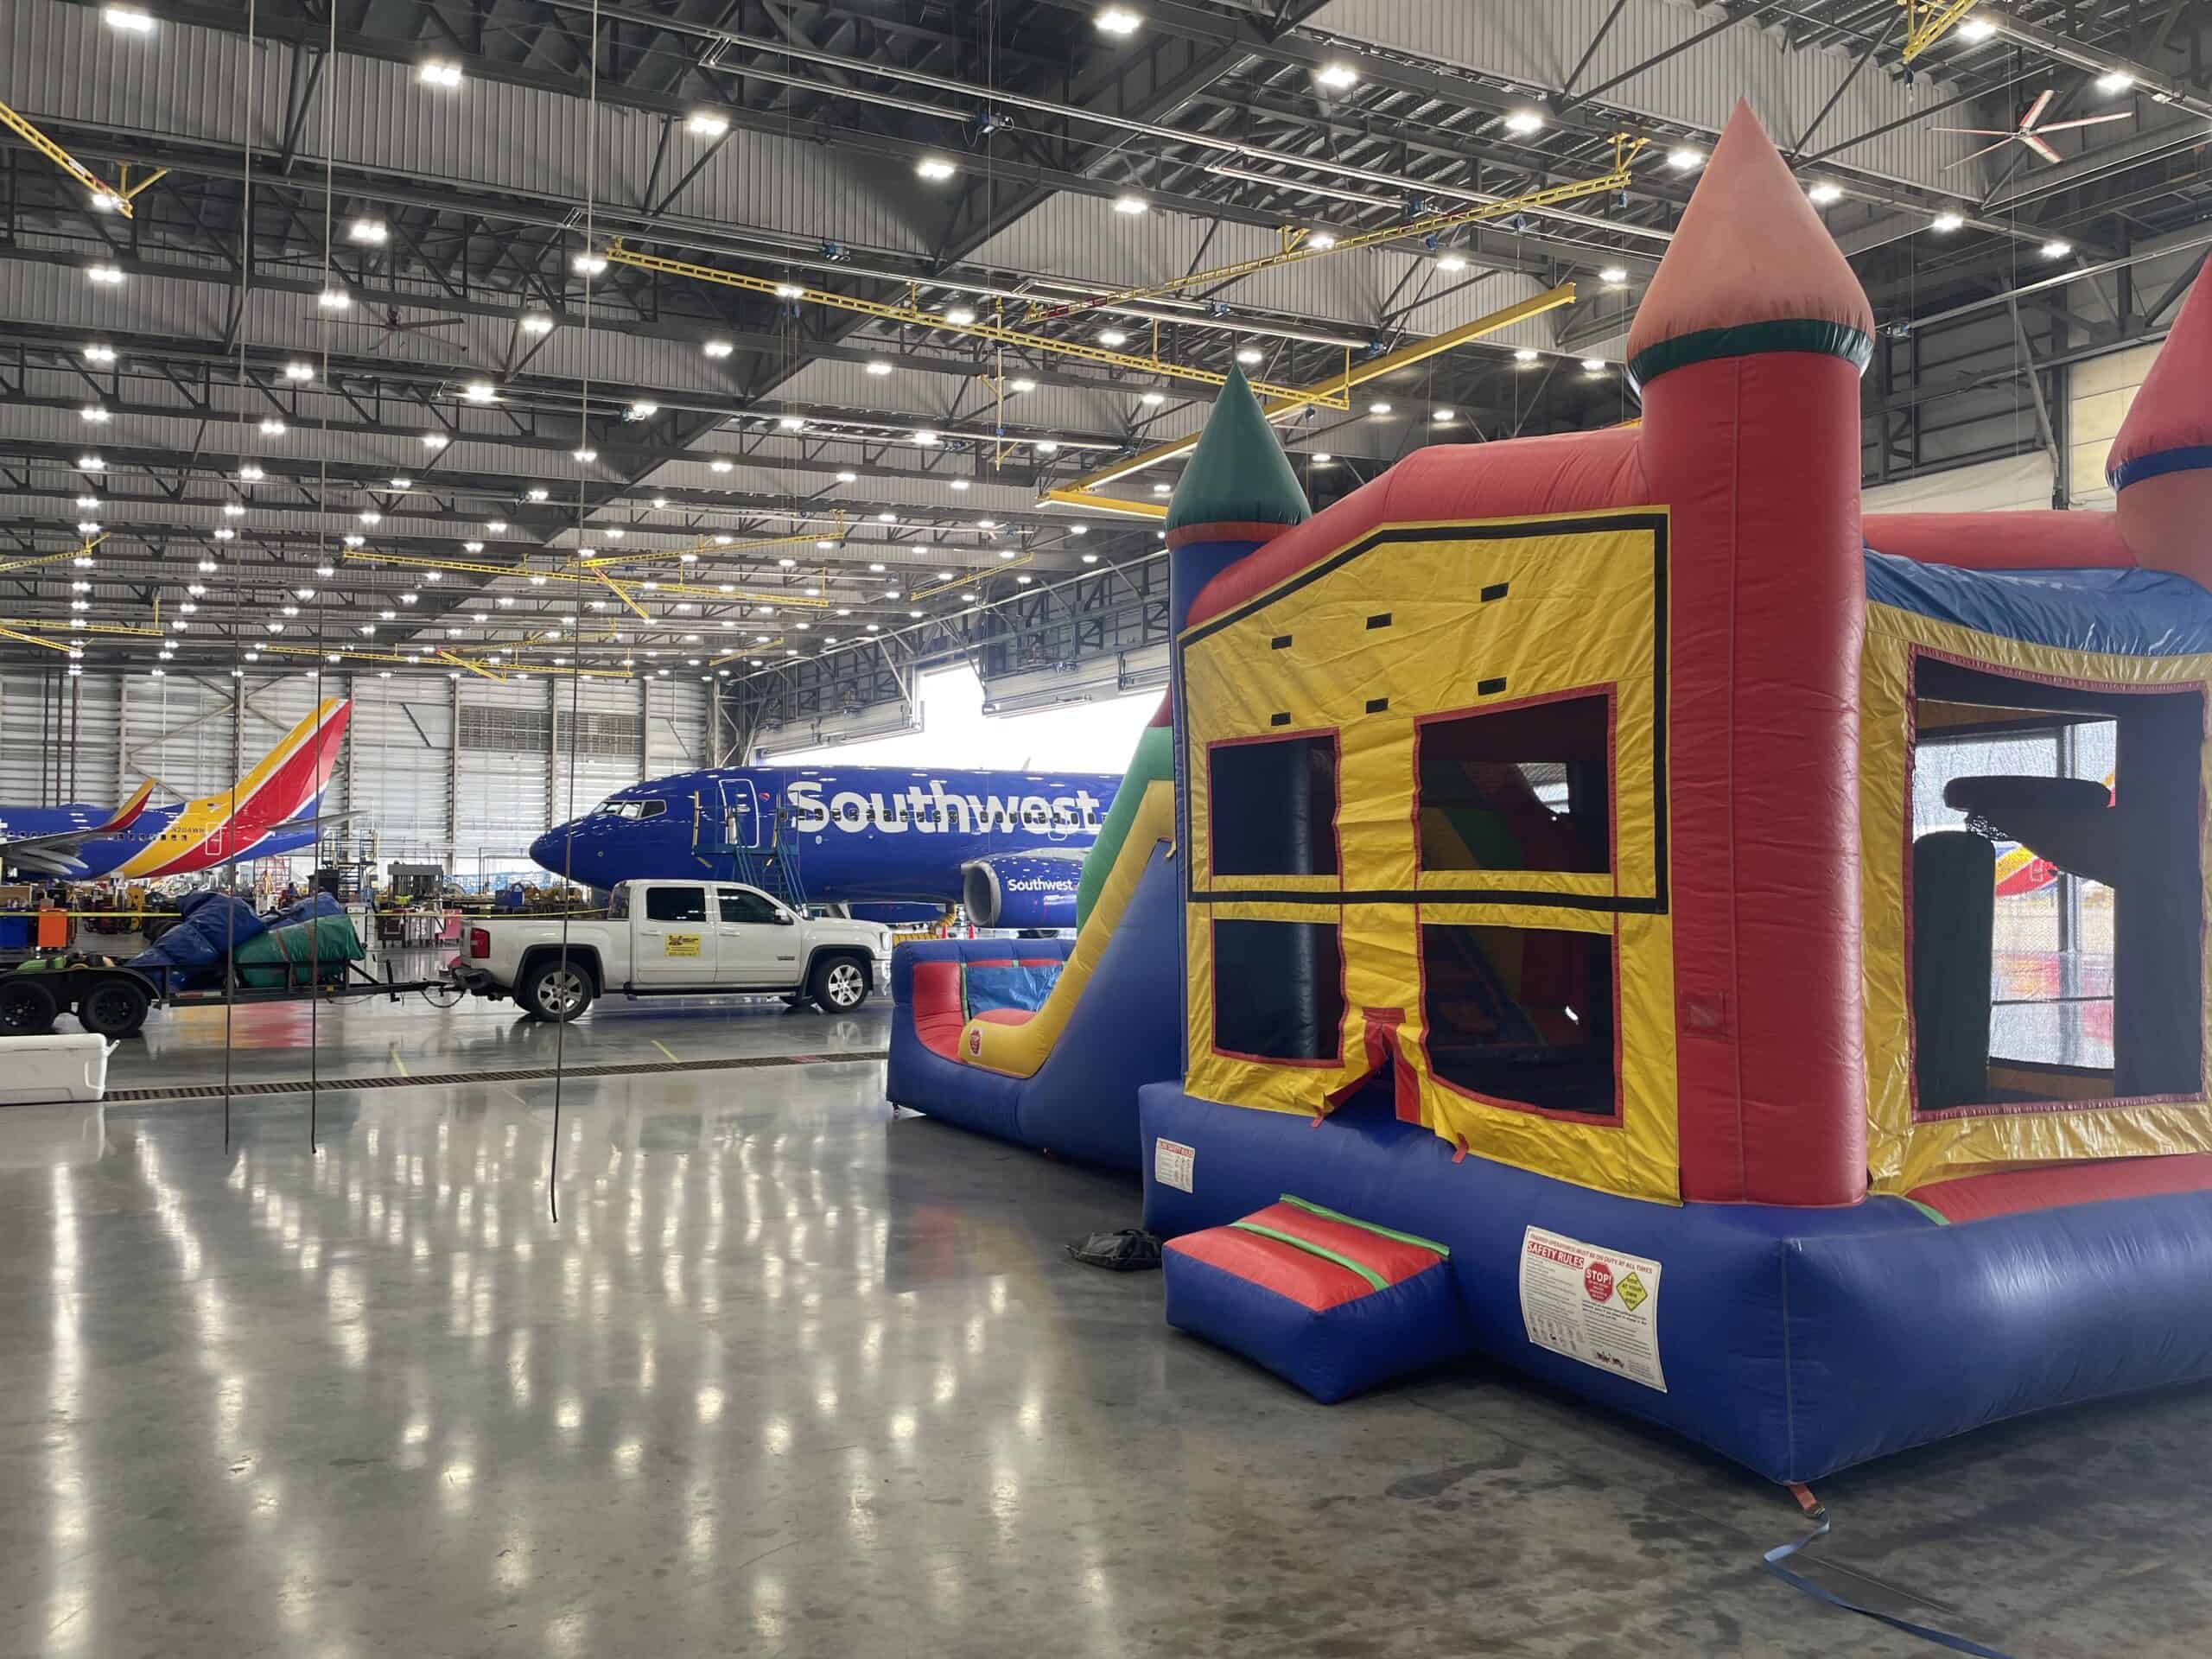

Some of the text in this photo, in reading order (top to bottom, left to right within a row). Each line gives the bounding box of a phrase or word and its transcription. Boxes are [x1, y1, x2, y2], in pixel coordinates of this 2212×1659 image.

[787, 780, 1101, 834] Southwest
[1008, 877, 1073, 891] Southwest
[1527, 1242, 1558, 1260] SAFETY
[1559, 1249, 1585, 1268] RULES
[1586, 1269, 1611, 1285] STOP!
